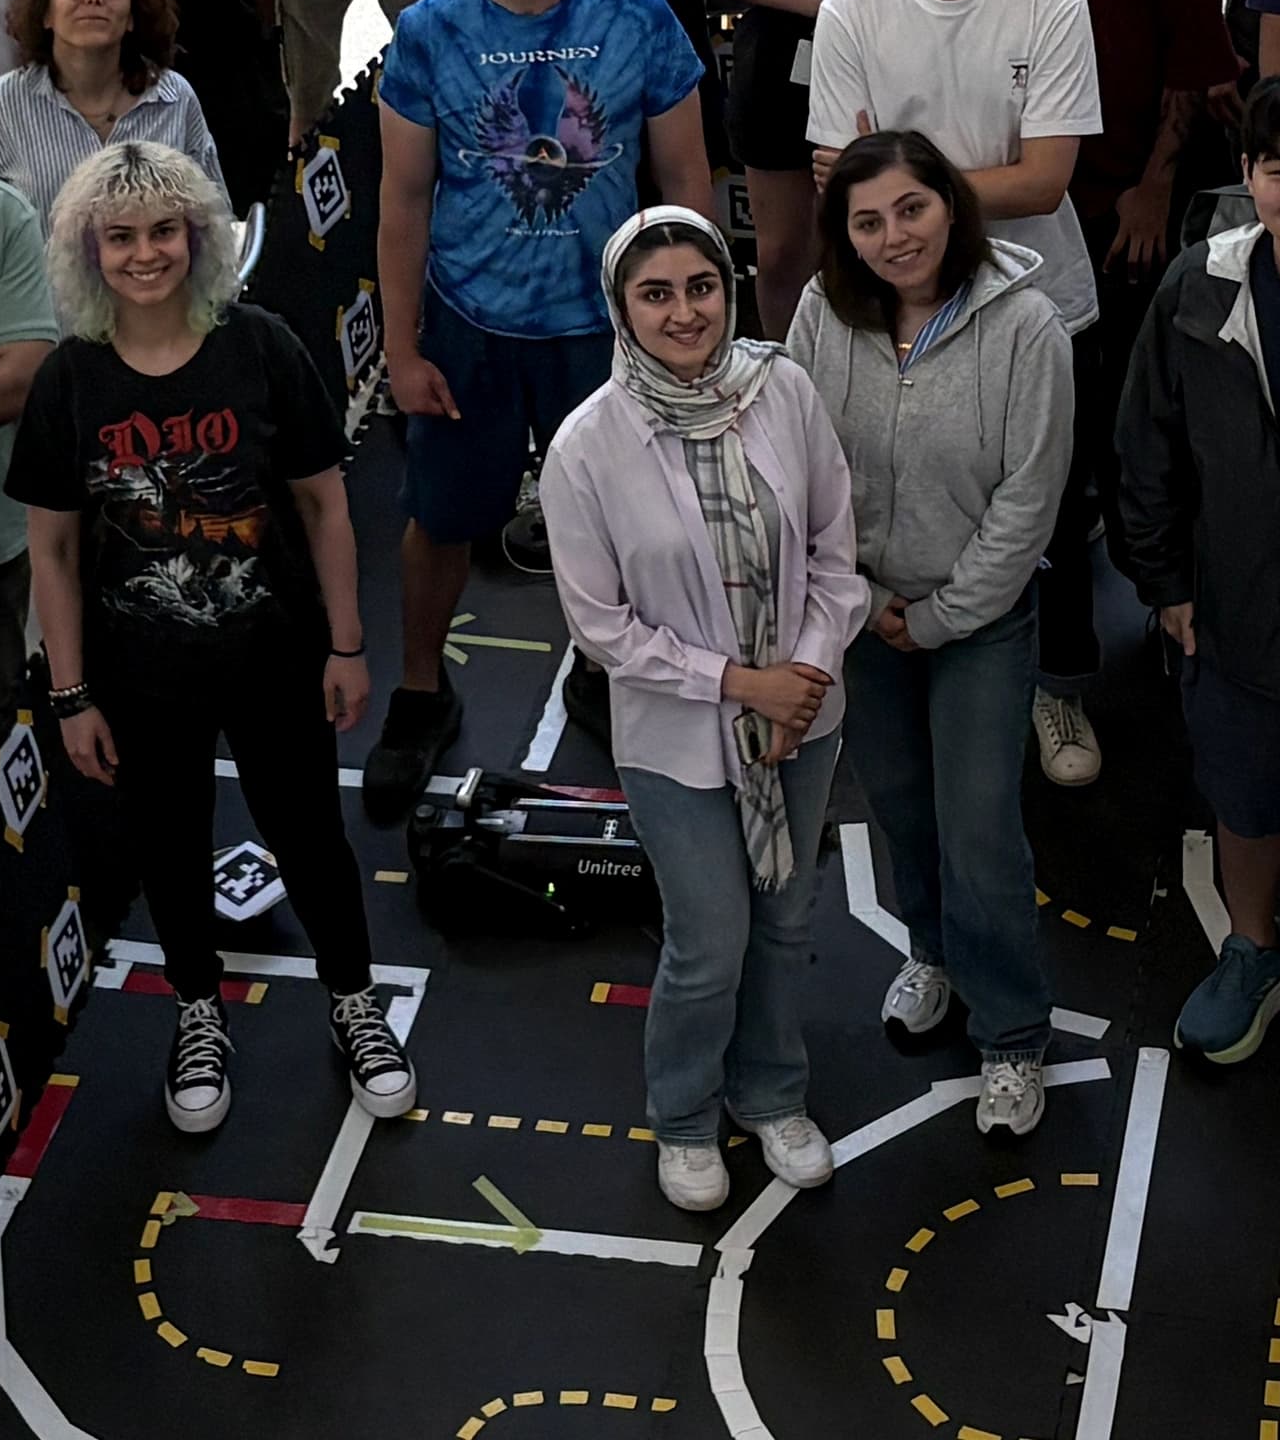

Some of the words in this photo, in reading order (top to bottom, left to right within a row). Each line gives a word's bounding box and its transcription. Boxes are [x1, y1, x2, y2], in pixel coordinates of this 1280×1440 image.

[480, 45, 600, 66] JOURNEY
[99, 408, 239, 480] DIO
[578, 859, 642, 877] Unitree
